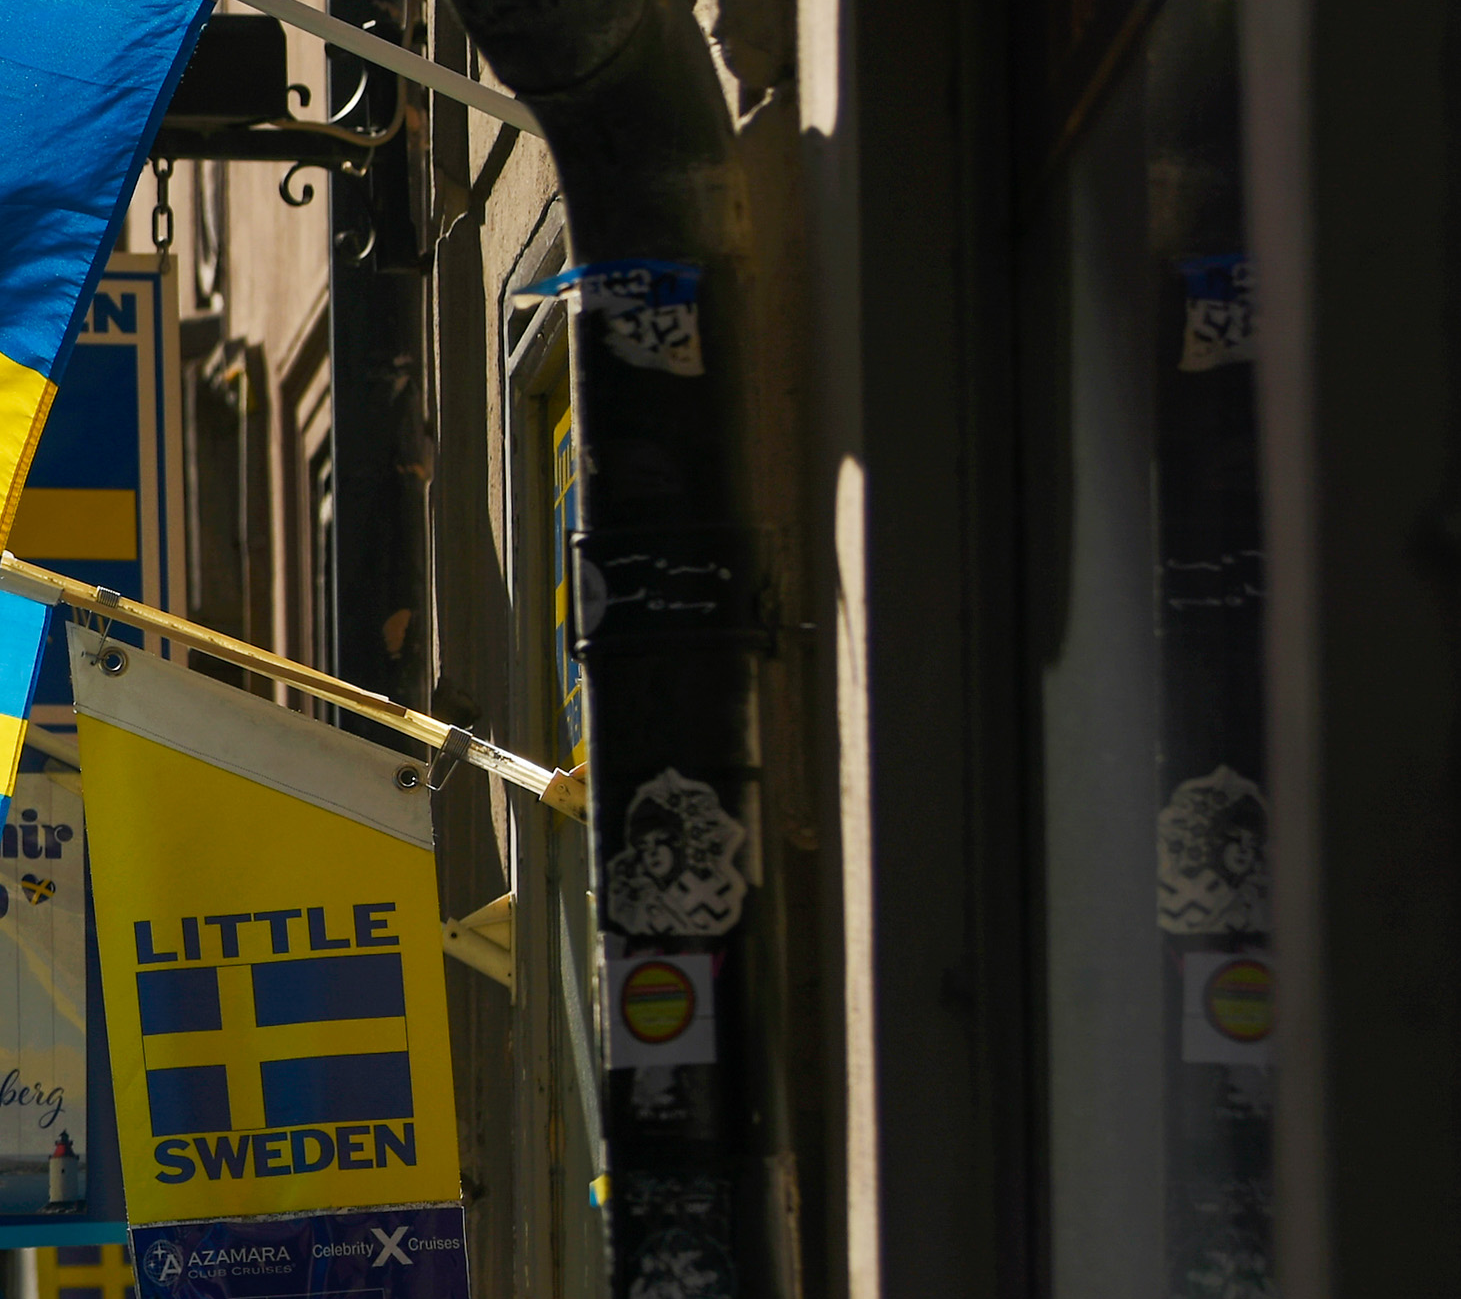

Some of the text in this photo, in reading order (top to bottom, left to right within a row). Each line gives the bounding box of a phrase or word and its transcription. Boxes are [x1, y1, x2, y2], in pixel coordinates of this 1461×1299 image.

[133, 902, 400, 964] LITTLE
[154, 1122, 417, 1184] SWEDEN
[187, 1245, 291, 1267] AZAMARA
[312, 1240, 374, 1260] Celebrity
[408, 1236, 461, 1252] Cruises
